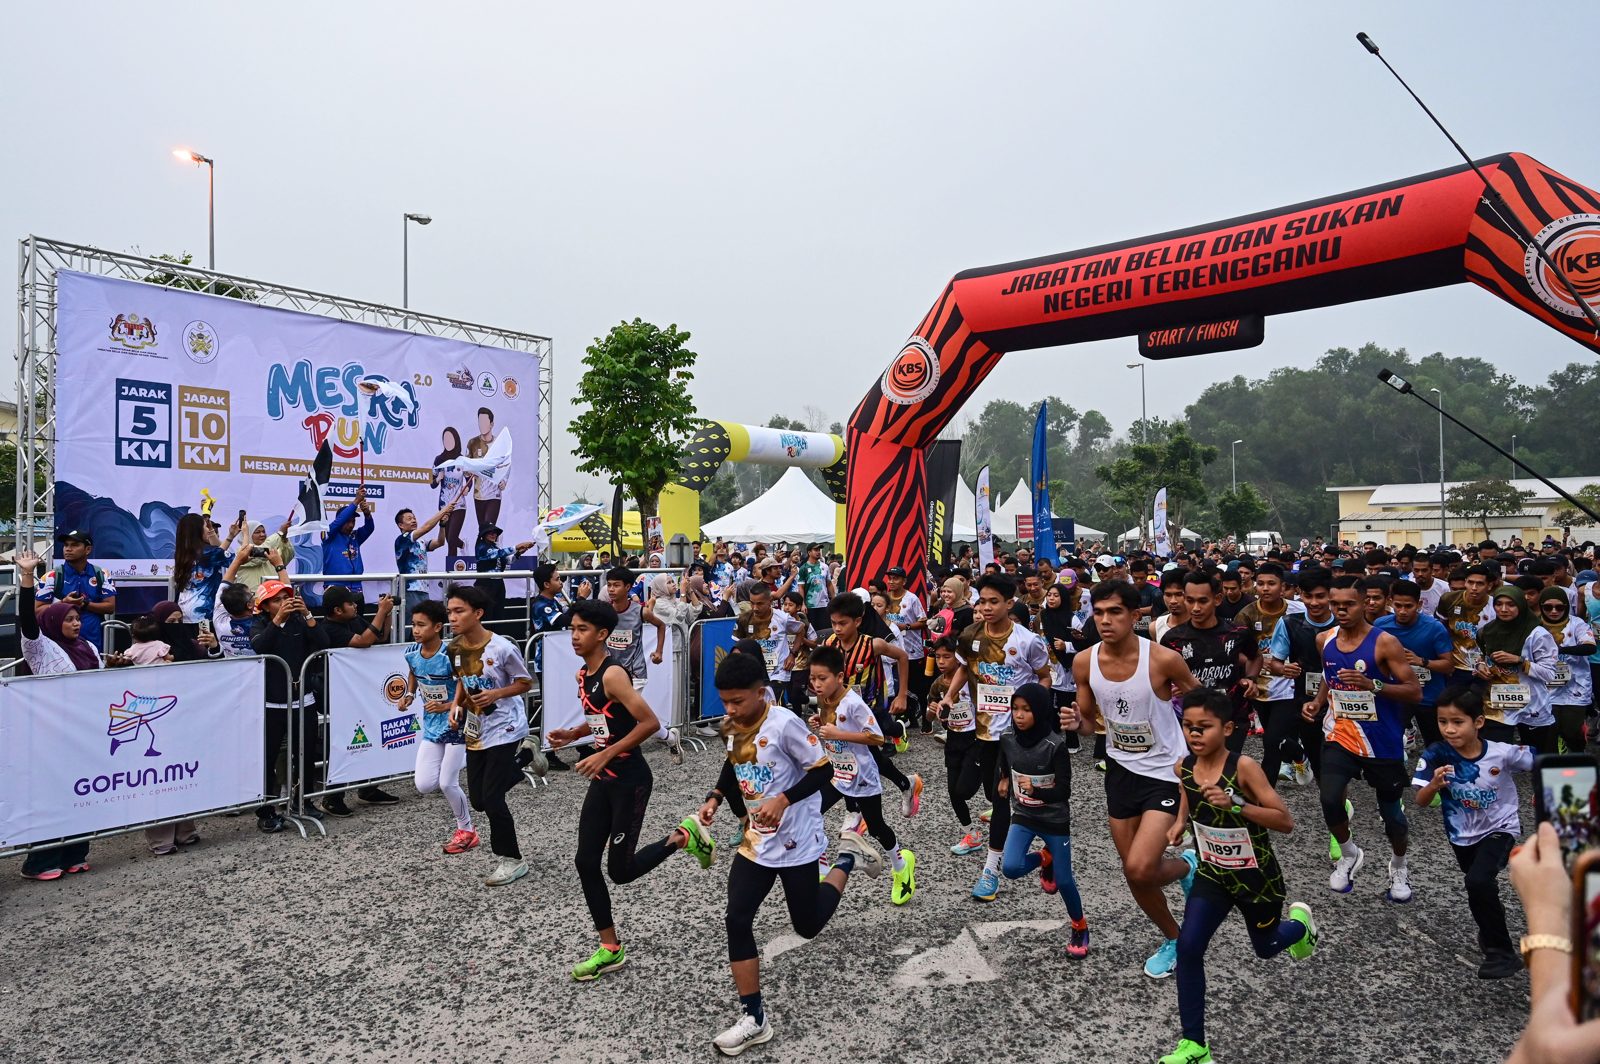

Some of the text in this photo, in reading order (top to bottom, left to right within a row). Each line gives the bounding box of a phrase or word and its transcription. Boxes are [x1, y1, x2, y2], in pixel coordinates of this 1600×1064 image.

[1001, 194, 1404, 295] JABATAN BELIA DAN SUKAN
[1044, 236, 1342, 314] NEGERI TERENGGANU
[1148, 327, 1186, 348] START
[1197, 320, 1240, 342] FINISH
[898, 363, 923, 377] KBS
[413, 373, 433, 387] 2.0
[121, 386, 167, 400] JARAK
[184, 393, 225, 406] JARAK
[130, 405, 157, 436] 5
[185, 411, 226, 440] 10
[780, 433, 808, 449] MESRA
[121, 440, 166, 462] KM
[184, 445, 225, 466] KM
[244, 460, 286, 472] MESRA
[379, 469, 430, 481] KEMAMAN
[391, 685, 404, 693] KBS
[984, 695, 1009, 704] 13923
[1497, 694, 1524, 702] 11588
[1340, 702, 1369, 711] 11896
[382, 718, 411, 732] RAKAN
[383, 727, 407, 739] MUDA
[1114, 732, 1146, 743] 11950
[387, 738, 416, 751] MADANI
[73, 760, 199, 796] GOFUN.MY
[734, 762, 773, 782] MESRA
[73, 783, 199, 809] FUN ACTIVE COMMUNITY
[1452, 788, 1497, 803] MESRA
[1206, 840, 1242, 855] 11897
